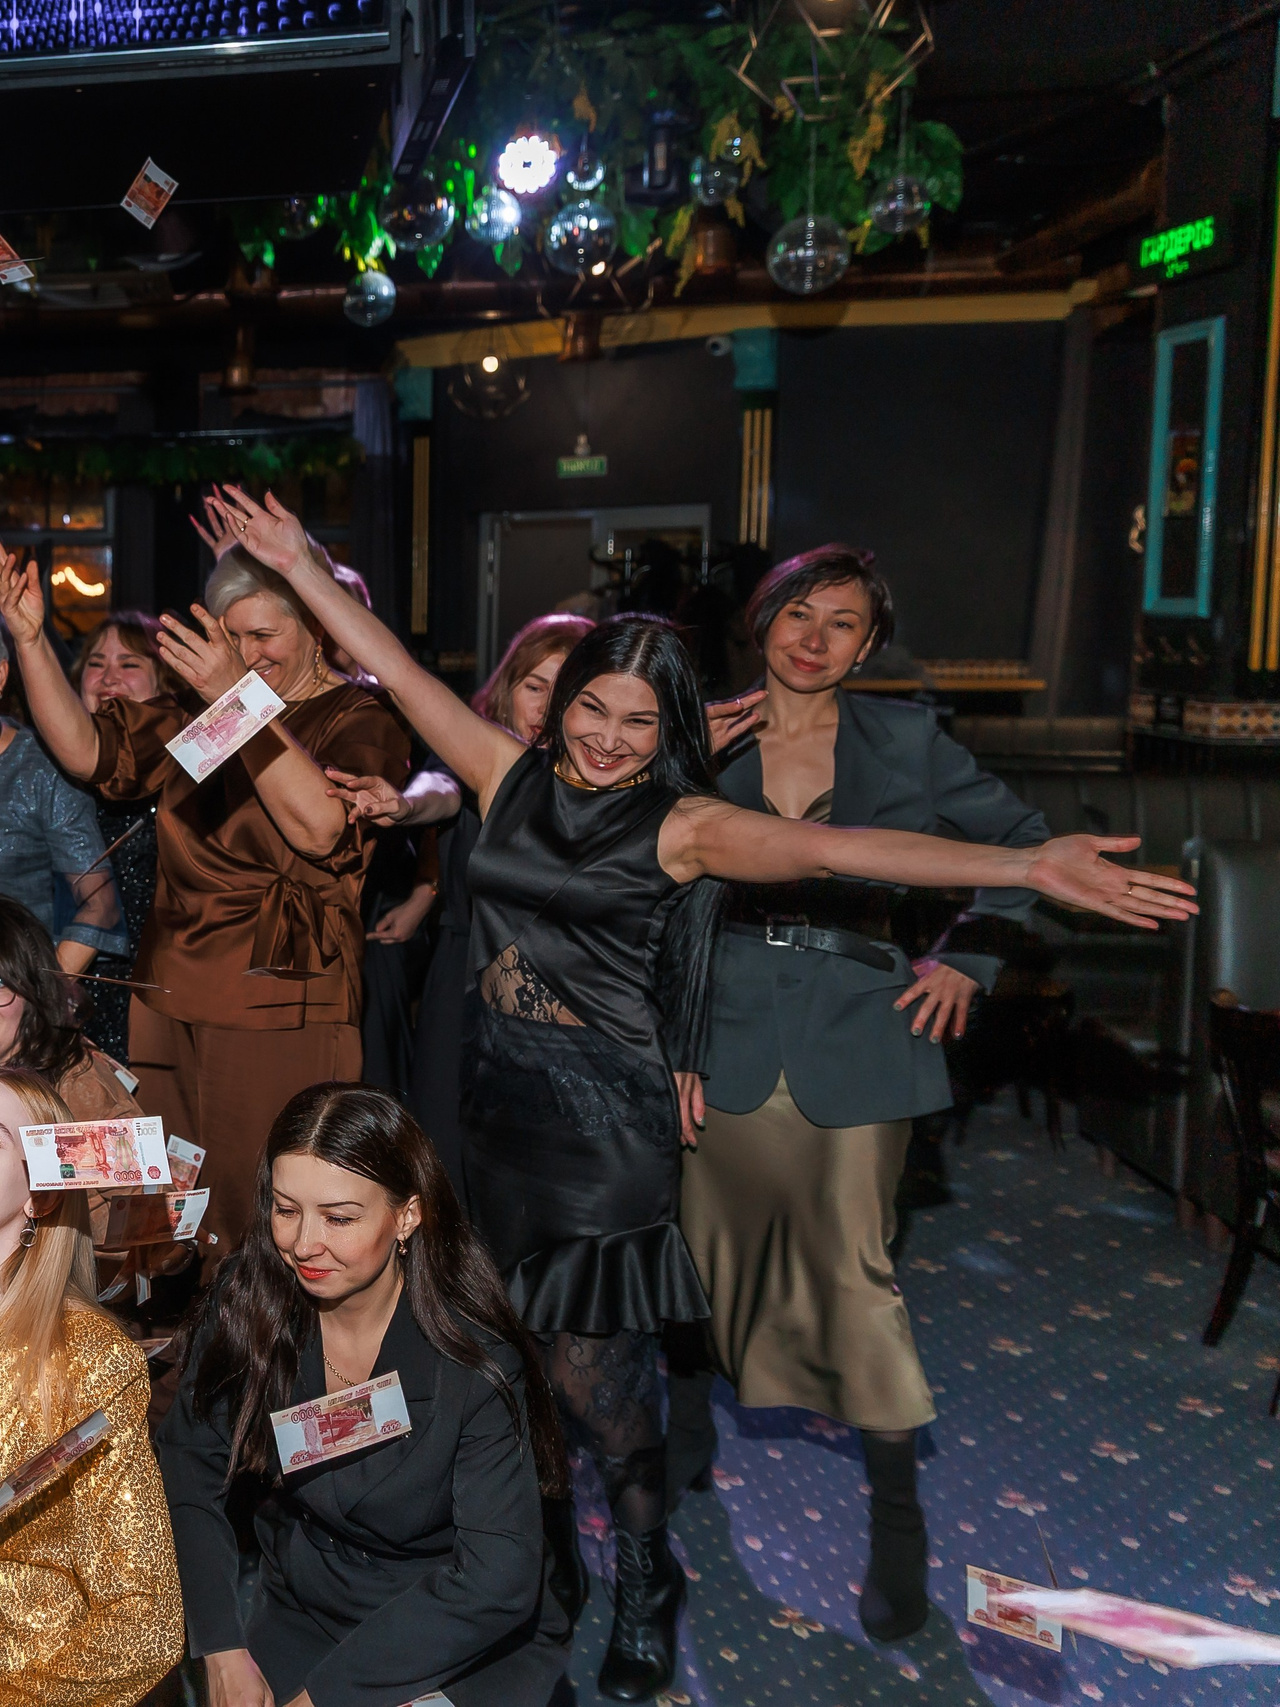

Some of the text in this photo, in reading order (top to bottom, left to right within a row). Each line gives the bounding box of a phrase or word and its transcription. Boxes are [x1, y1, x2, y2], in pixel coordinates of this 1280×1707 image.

[182, 721, 206, 744] 5000
[113, 1169, 142, 1182] 5000
[290, 1403, 322, 1424] 5000
[380, 1421, 401, 1434] 5000
[64, 1436, 94, 1462] 5000
[290, 1452, 310, 1466] 5000
